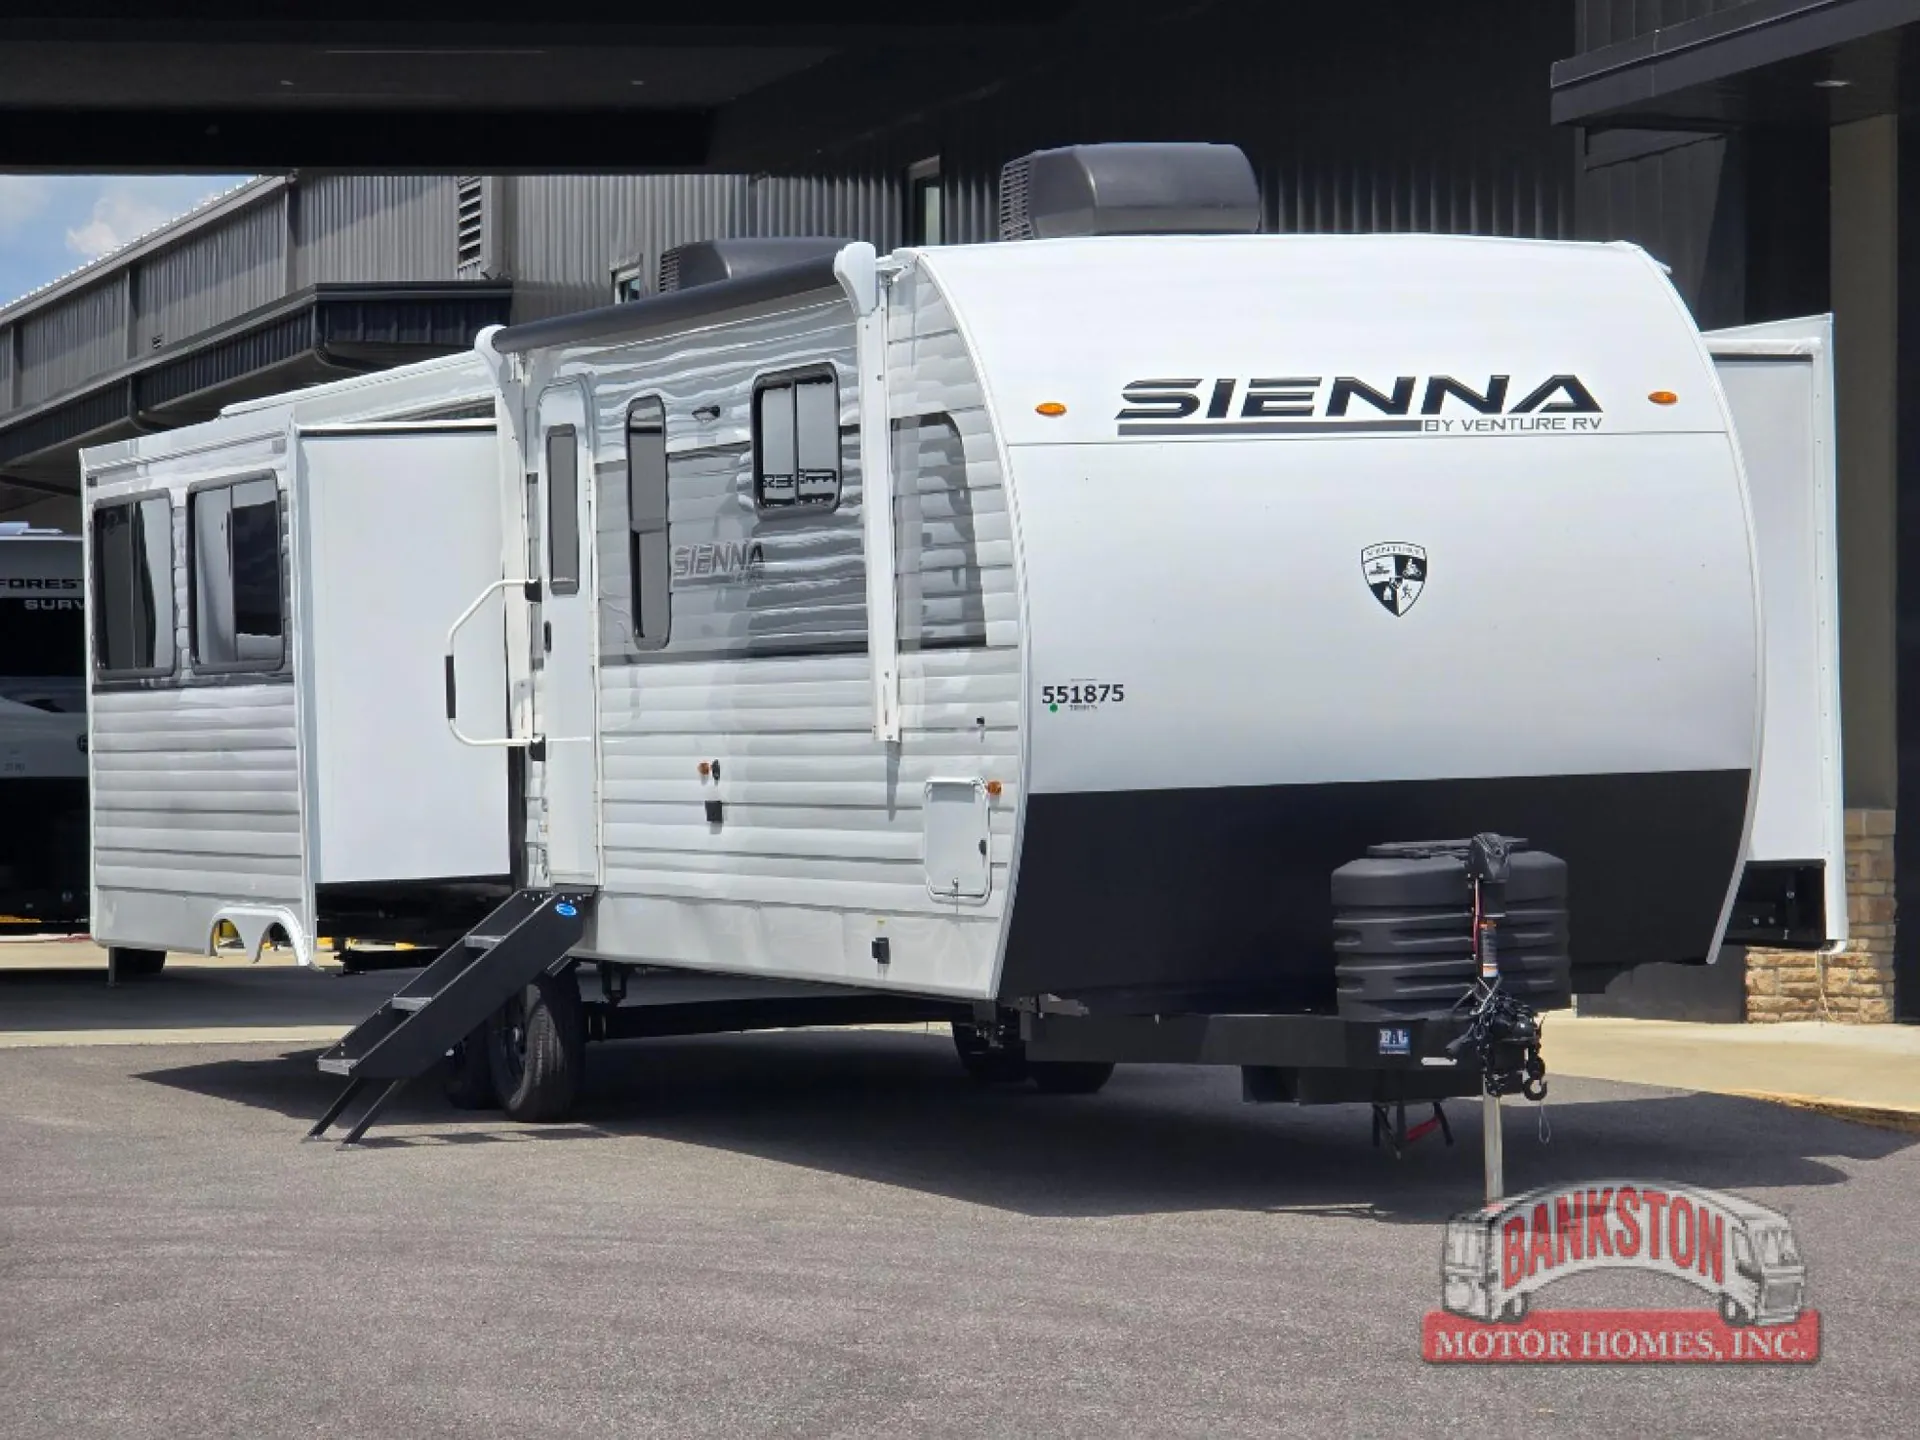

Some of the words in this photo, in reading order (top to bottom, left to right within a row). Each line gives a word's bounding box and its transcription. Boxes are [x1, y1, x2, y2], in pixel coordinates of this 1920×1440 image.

[1114, 374, 1604, 419] SIENNA
[1424, 418, 1454, 432] BY
[1461, 417, 1566, 431] VENTURE
[1572, 416, 1602, 430] RV
[674, 541, 764, 576] SIENNA
[1042, 683, 1125, 704] 551875
